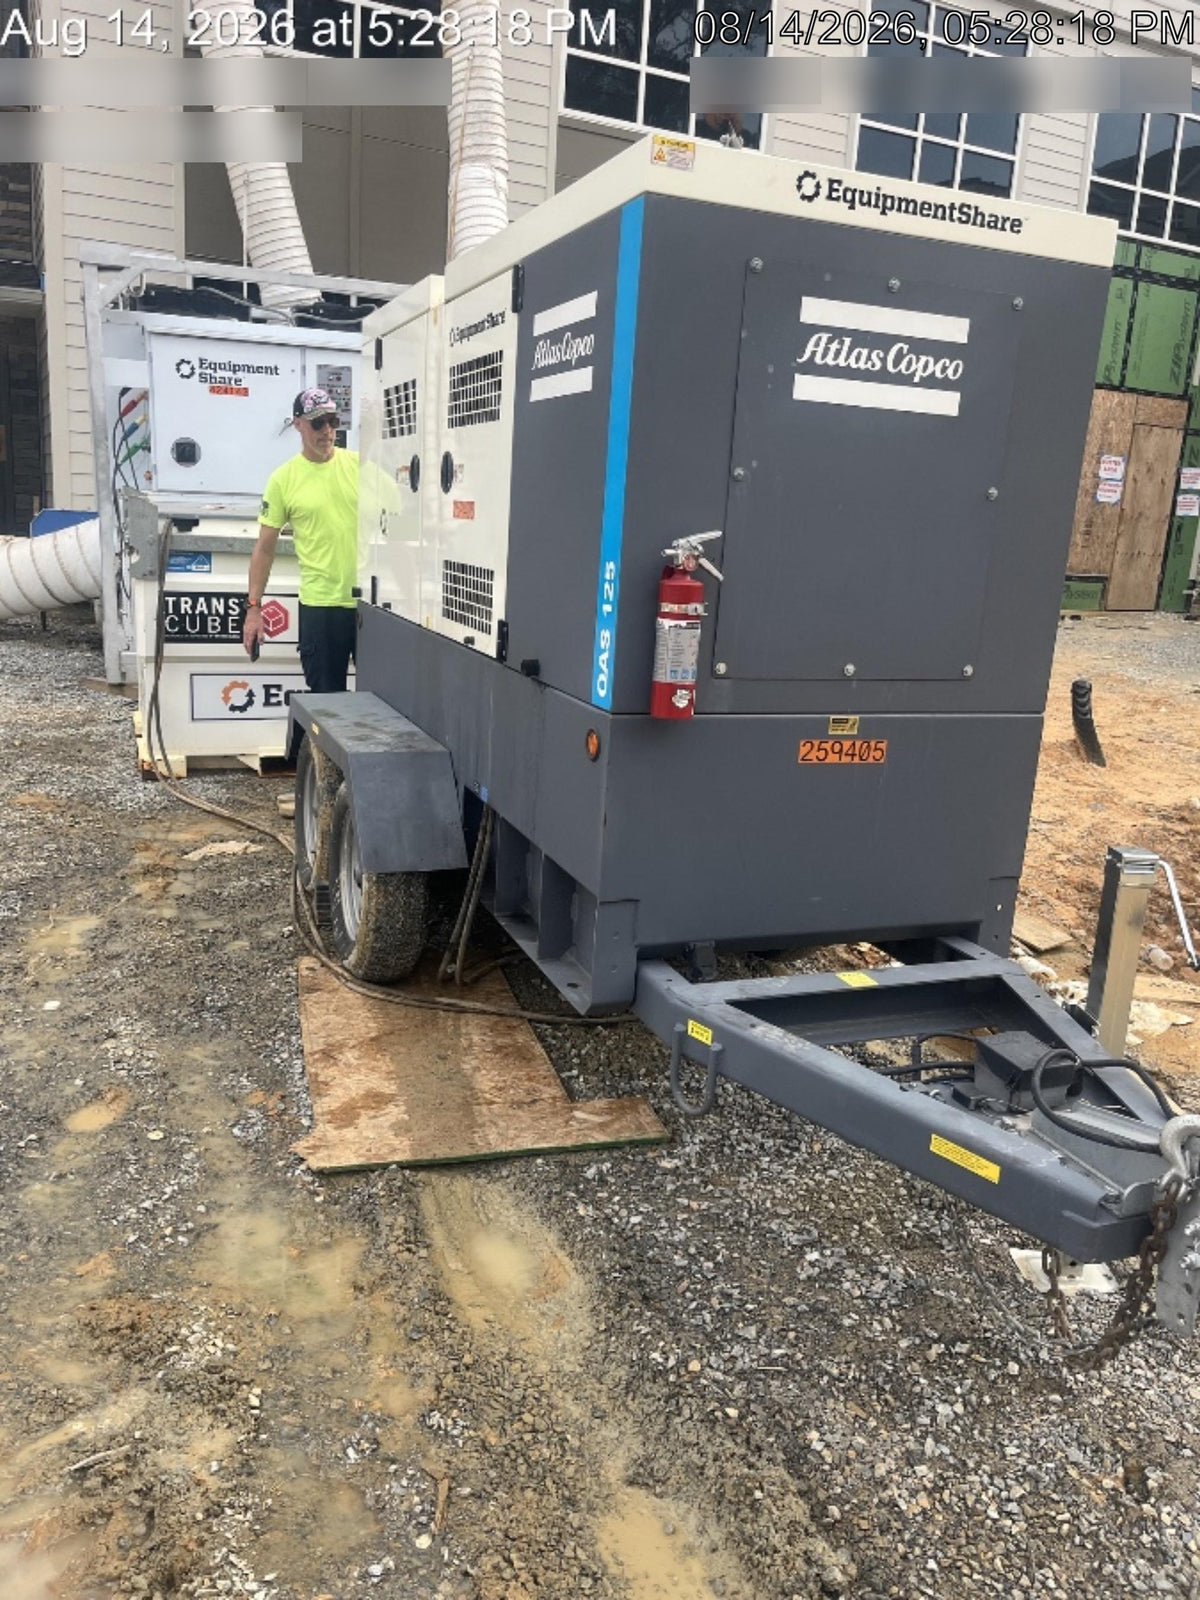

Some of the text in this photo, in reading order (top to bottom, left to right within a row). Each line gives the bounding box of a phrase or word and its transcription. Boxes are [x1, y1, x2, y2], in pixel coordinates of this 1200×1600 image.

[826, 178, 1023, 234] EquipmentShare
[531, 331, 595, 370] Atlas Copco
[796, 332, 964, 383] Atlas Copco
[198, 357, 280, 376] Equipment
[198, 371, 243, 386] Share
[164, 597, 240, 615] TRANS
[164, 614, 241, 633] CUBE
[597, 561, 616, 698] OAS 125
[801, 740, 885, 762] 259405
